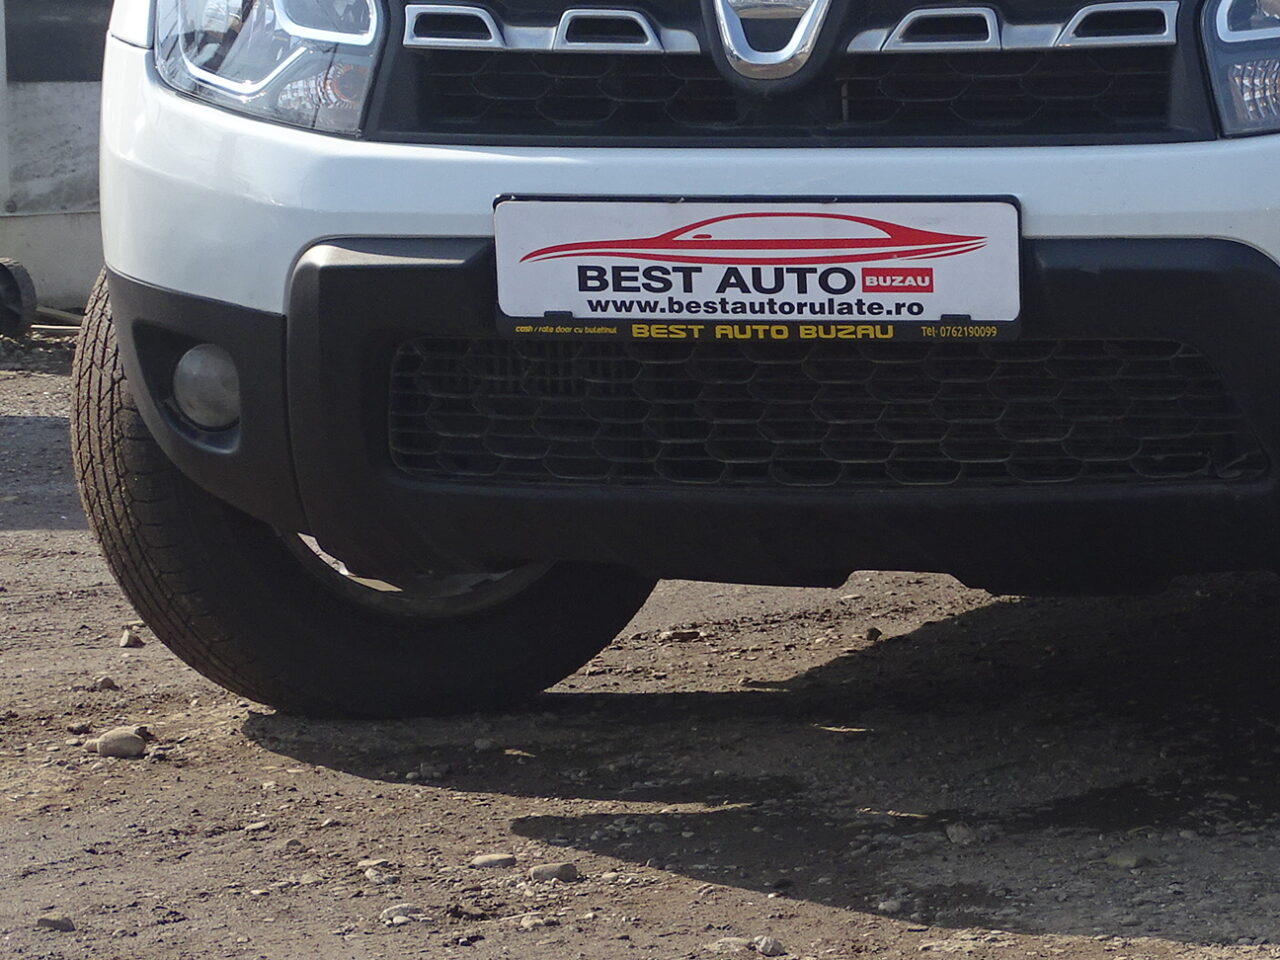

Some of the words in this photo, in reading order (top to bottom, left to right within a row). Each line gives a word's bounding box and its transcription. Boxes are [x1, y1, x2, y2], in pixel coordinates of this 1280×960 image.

[577, 265, 702, 293] BEST
[715, 266, 856, 295] AUTO
[865, 273, 931, 288] BUZAU
[586, 297, 924, 317] www.bestautorulate.ro
[631, 324, 705, 339] BEST
[715, 325, 789, 340] AUTO
[799, 325, 894, 339] BUZAU
[940, 326, 998, 338] 0762190099
